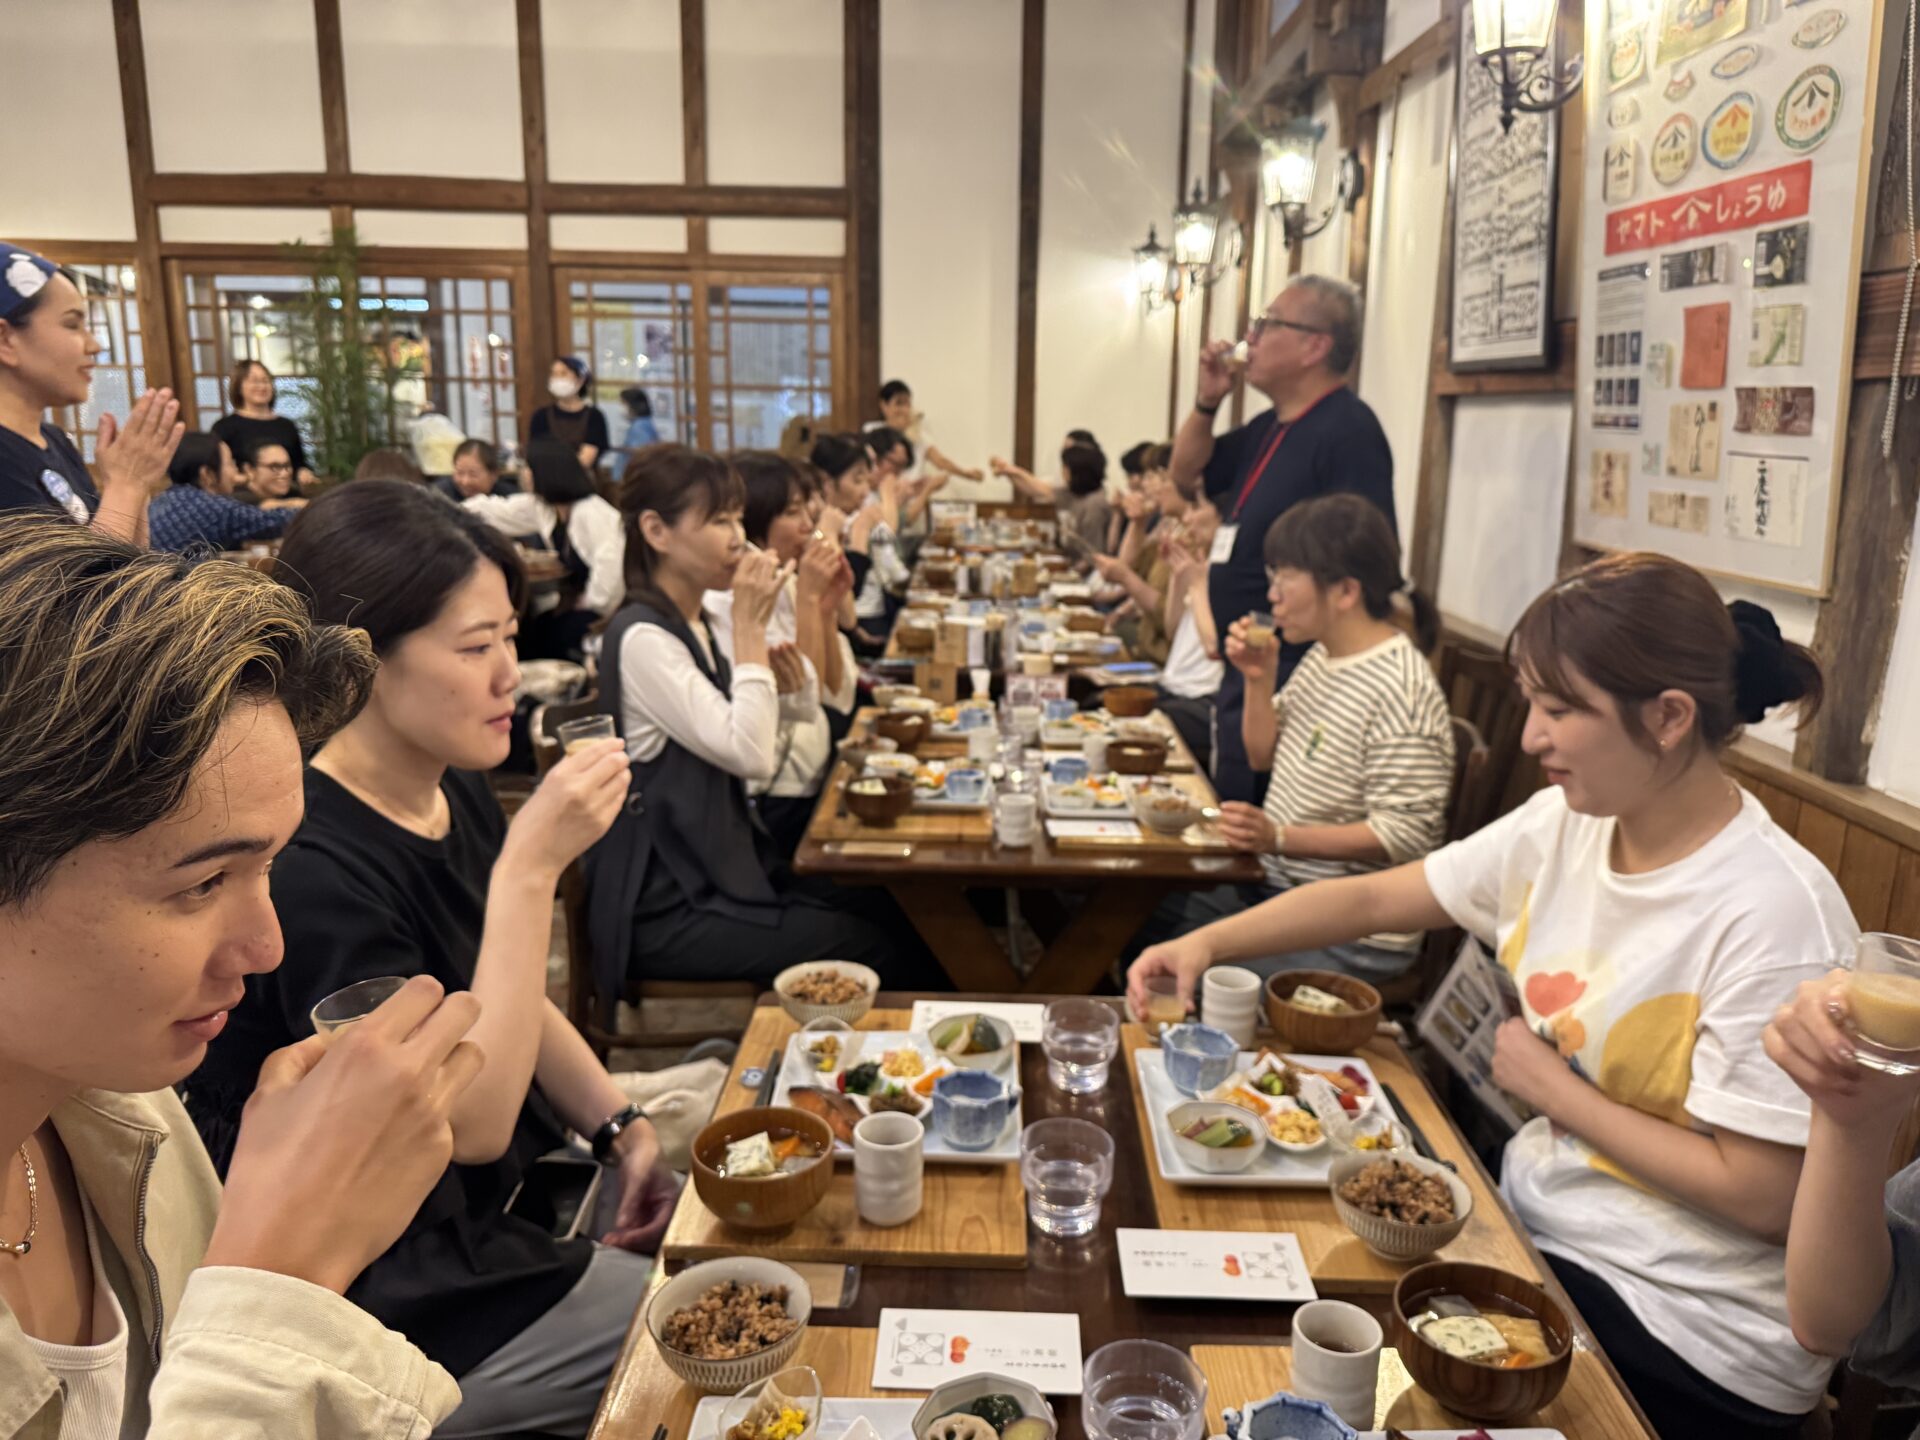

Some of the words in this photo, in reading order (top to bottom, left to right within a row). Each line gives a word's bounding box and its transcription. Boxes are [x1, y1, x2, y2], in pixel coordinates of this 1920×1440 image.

[1616, 209, 1665, 245] ヤマト
[1716, 178, 1787, 224] しょうゆ
